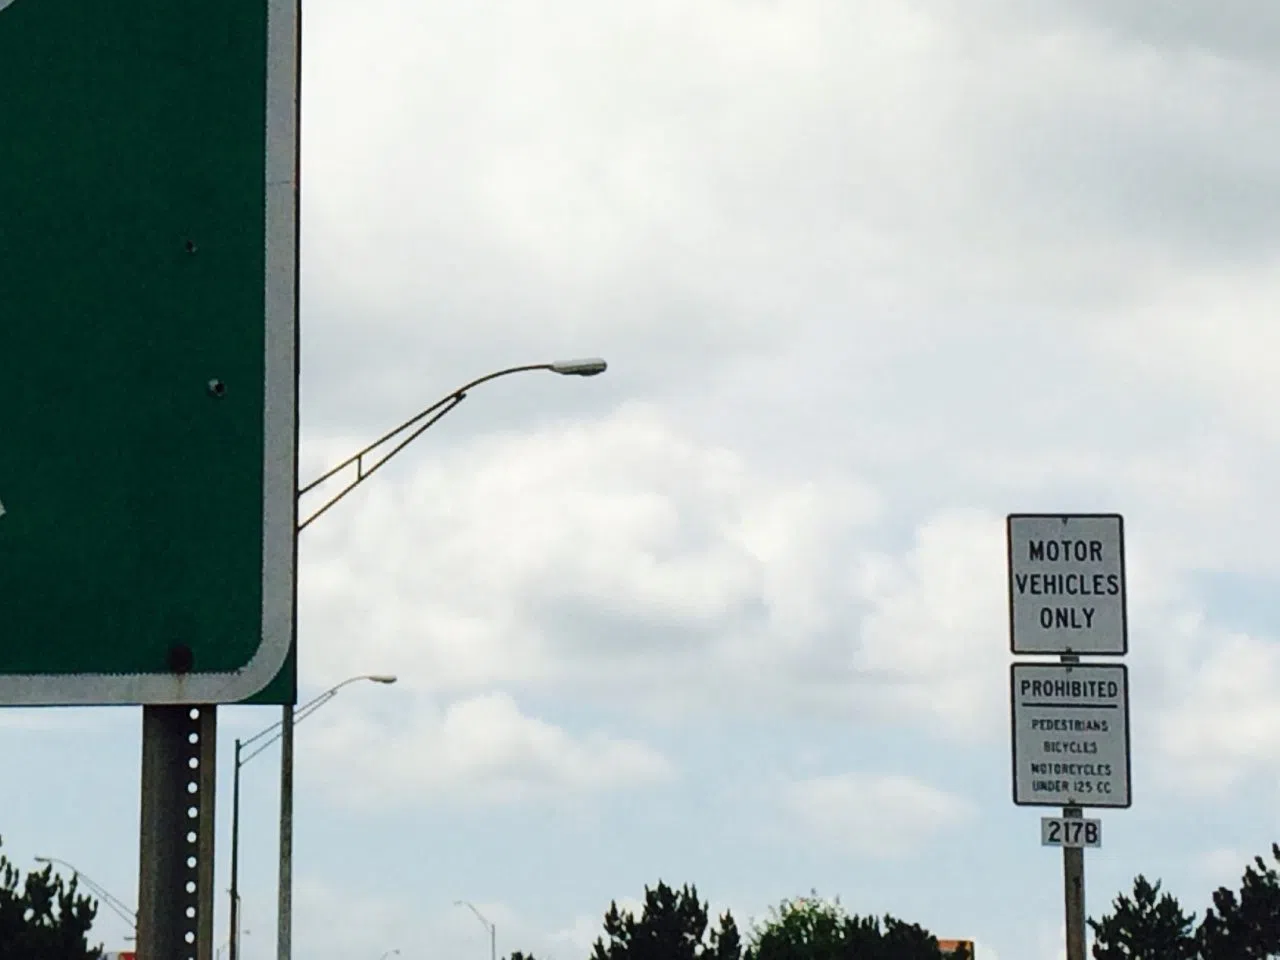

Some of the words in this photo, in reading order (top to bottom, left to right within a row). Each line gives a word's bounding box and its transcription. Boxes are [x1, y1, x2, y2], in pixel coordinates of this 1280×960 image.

[1029, 539, 1103, 562] MOTOR
[1015, 573, 1120, 596] VEHICLES
[1039, 607, 1095, 630] ONLY
[1021, 679, 1118, 699] PROHIBITED
[1031, 719, 1109, 732] PEDESTRIANS
[1043, 741, 1097, 754] BICYCLES
[1031, 763, 1112, 777] MOTORCYCLES
[1032, 780, 1070, 793] UNDER
[1073, 780, 1093, 794] 125
[1096, 781, 1112, 795] CC
[1048, 820, 1099, 844] 217B
